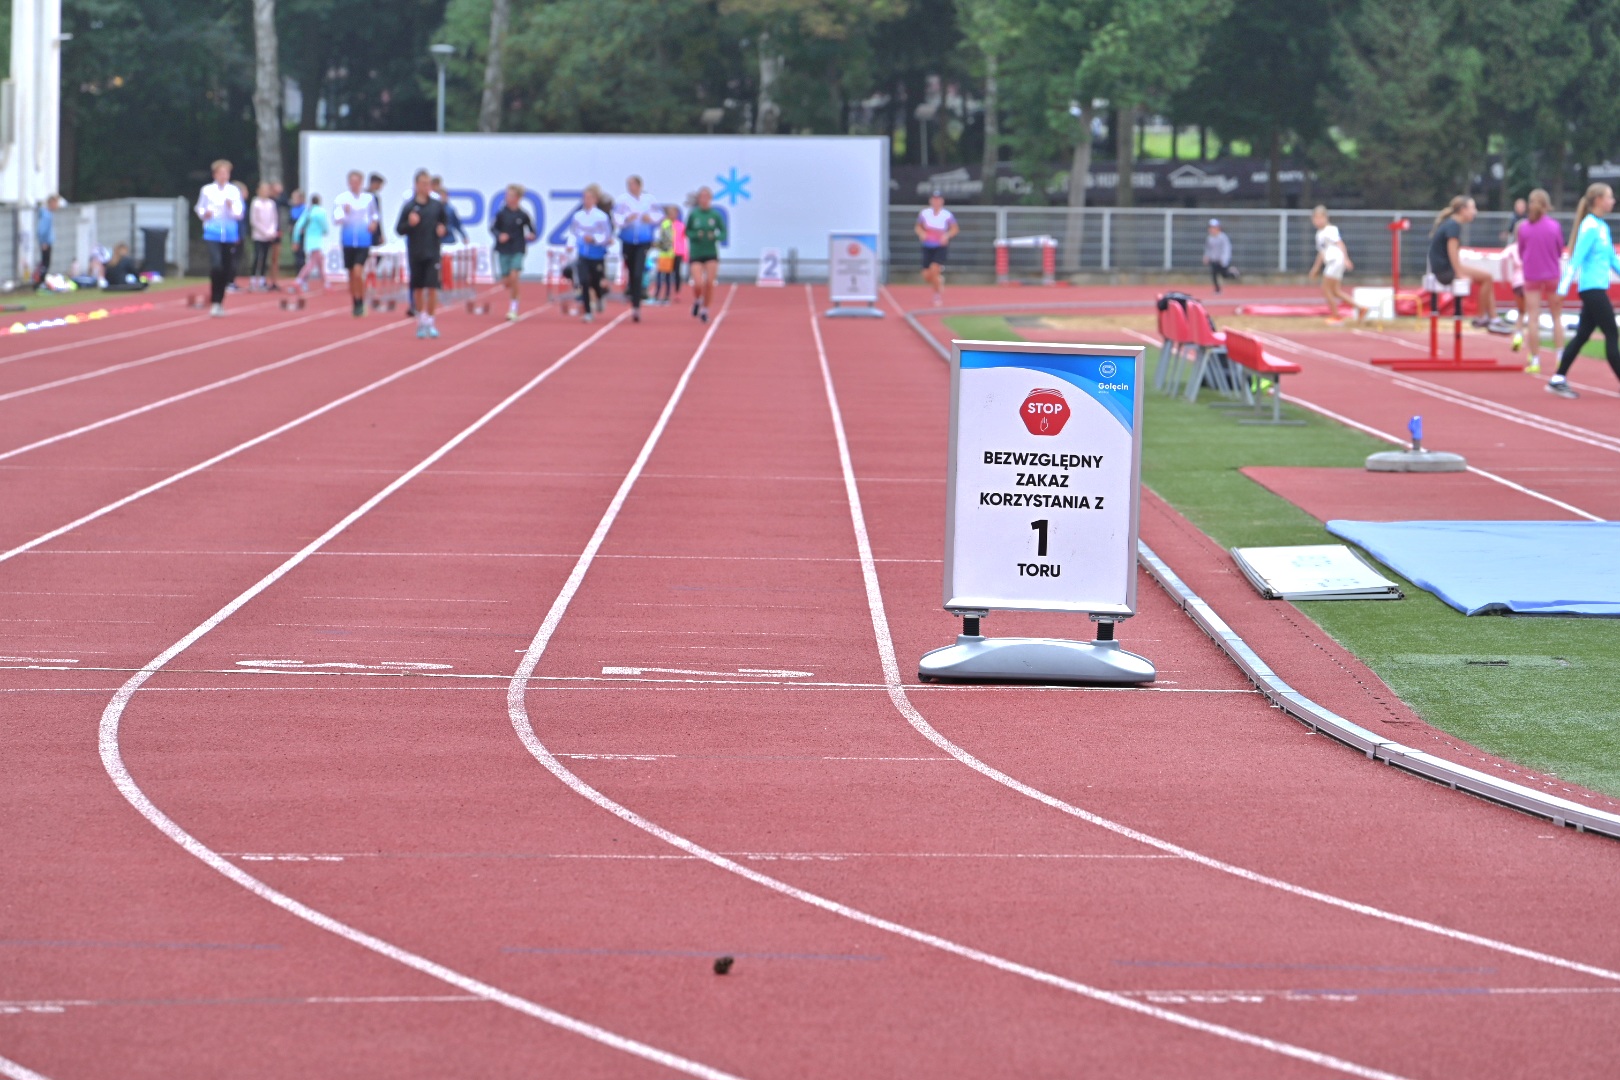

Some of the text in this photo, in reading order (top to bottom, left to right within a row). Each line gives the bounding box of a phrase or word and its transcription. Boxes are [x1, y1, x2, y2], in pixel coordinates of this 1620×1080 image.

[763, 254, 778, 275] 2
[1027, 402, 1063, 415] STOP
[983, 451, 1104, 470] BEZWZGLĘDNY
[1015, 473, 1070, 488] ZAKAZ
[979, 492, 1104, 509] KORZYSTANIA Z
[1030, 519, 1049, 557] 1
[1017, 563, 1061, 577] TORU
